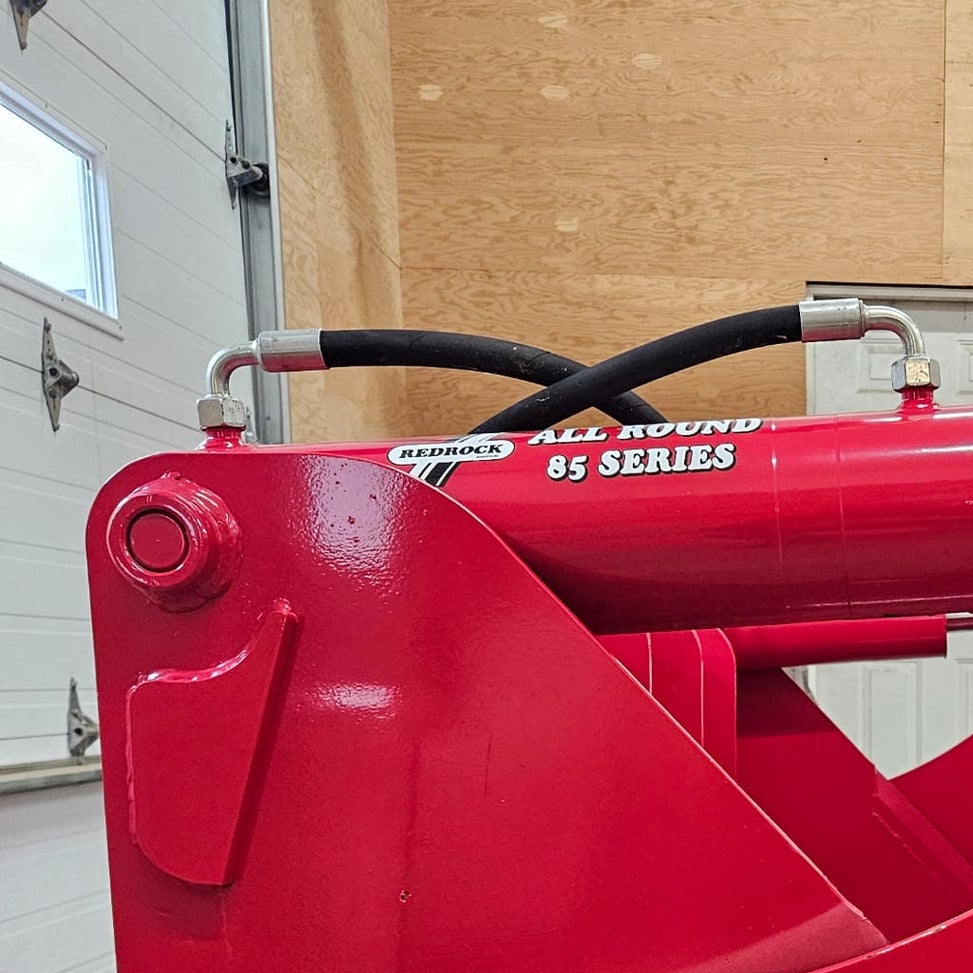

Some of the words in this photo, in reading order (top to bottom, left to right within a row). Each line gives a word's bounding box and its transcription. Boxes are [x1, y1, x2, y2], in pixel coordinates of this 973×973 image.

[528, 427, 608, 445] ALL
[617, 418, 762, 440] ROUND
[399, 444, 503, 459] REDROCK
[547, 454, 588, 482] 85
[598, 443, 737, 477] SERIES
